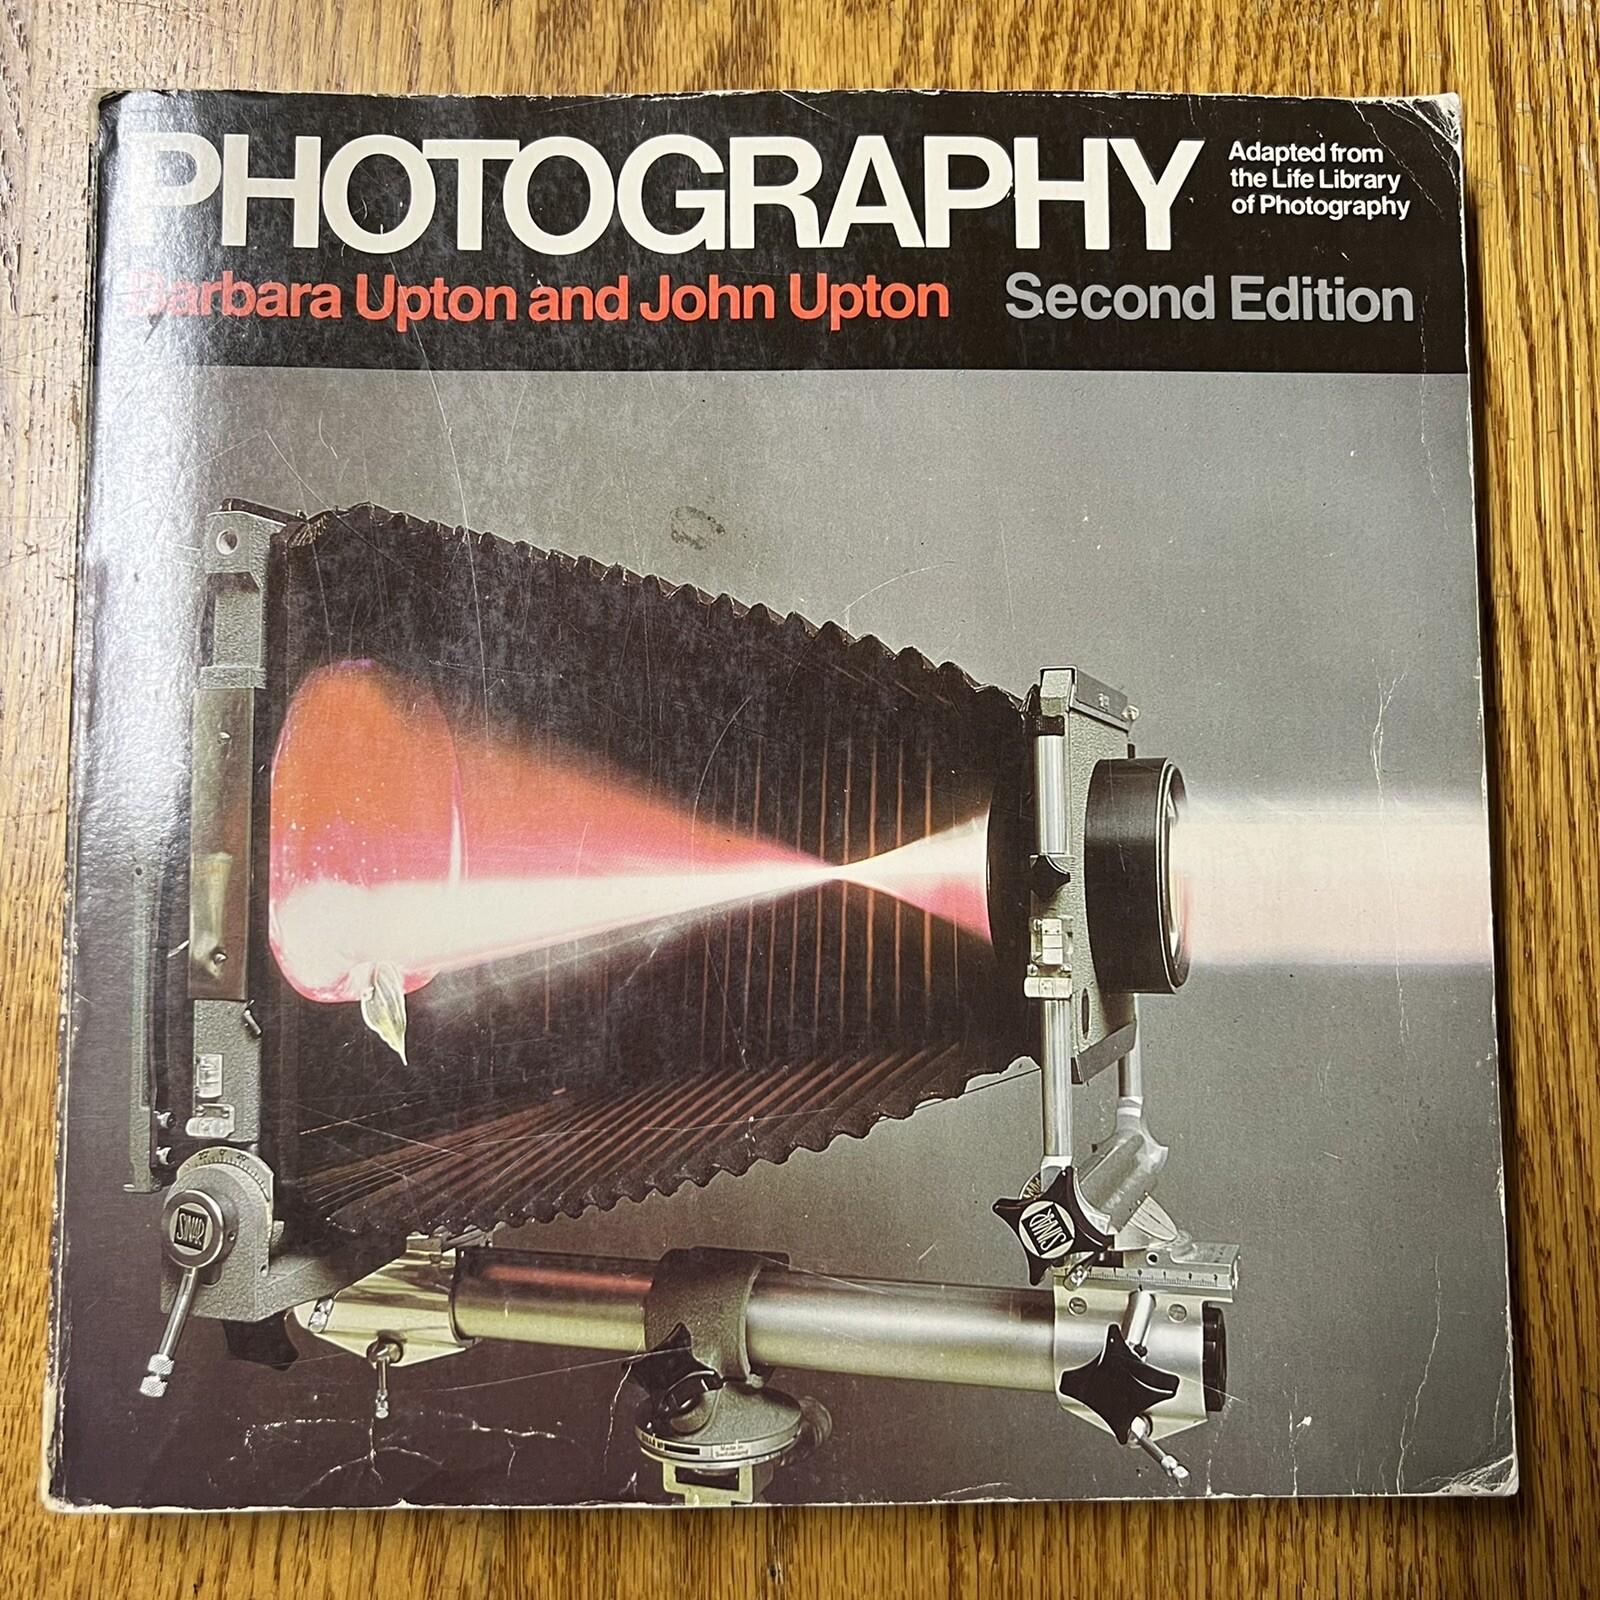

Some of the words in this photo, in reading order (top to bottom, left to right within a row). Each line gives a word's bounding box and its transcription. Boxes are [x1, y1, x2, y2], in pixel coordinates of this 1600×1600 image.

[1228, 140, 1326, 163] Adapted
[1329, 140, 1384, 163] from
[130, 132, 1204, 256] PHOTOGRAPHY
[1230, 167, 1268, 188] the
[1272, 168, 1315, 189] Life
[1319, 168, 1401, 194] Library
[1231, 193, 1256, 214] of
[1260, 194, 1411, 221] Photography
[128, 268, 343, 320] Barbara
[355, 273, 518, 333] Upton
[528, 274, 630, 322] and
[639, 273, 776, 322] John
[788, 272, 951, 332] Upton
[1005, 271, 1216, 321] Second
[1230, 275, 1414, 322] Edition
[176, 1212, 205, 1246] SINAR
[1029, 1208, 1067, 1251] SINAR
